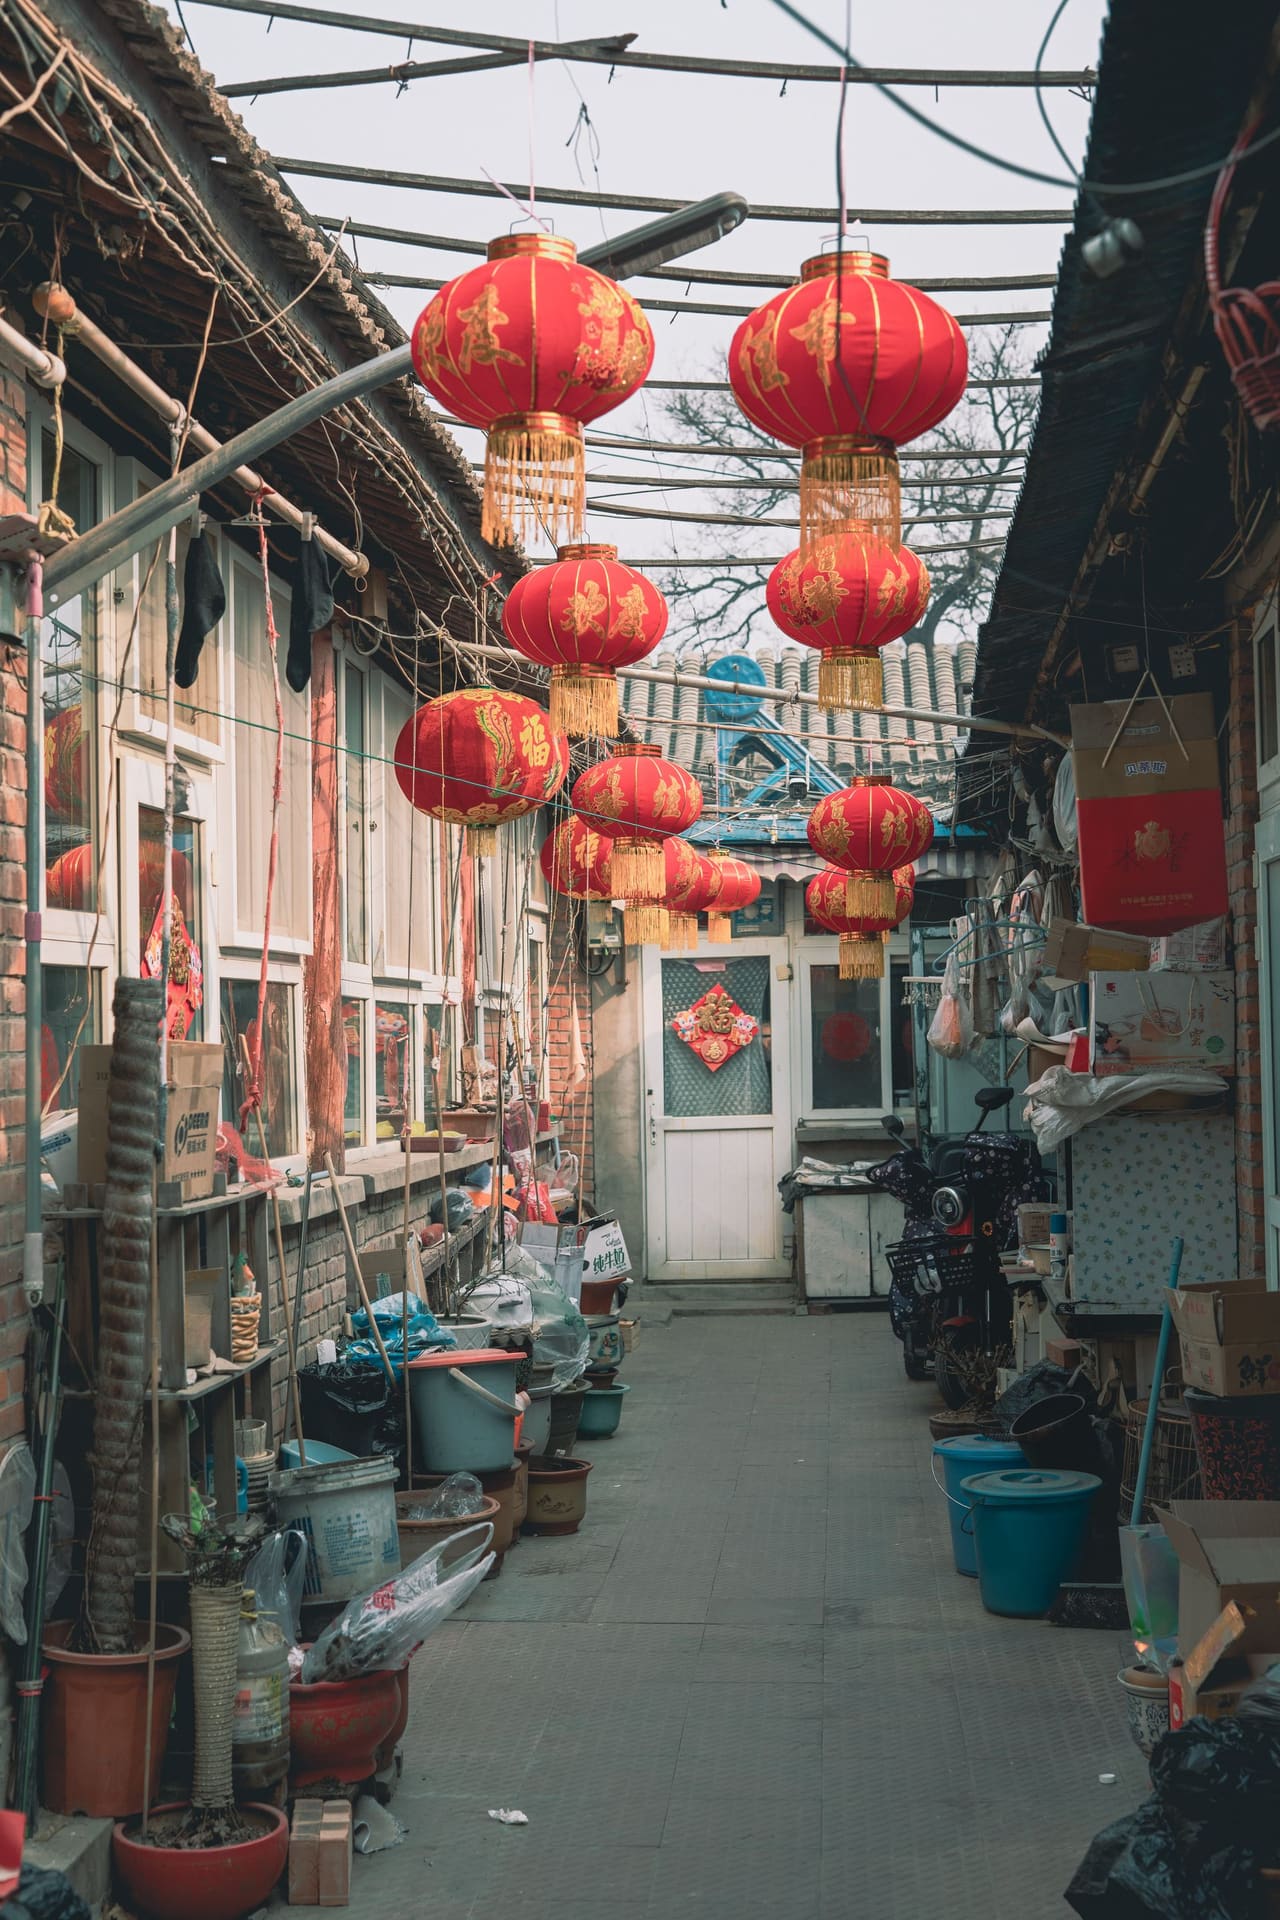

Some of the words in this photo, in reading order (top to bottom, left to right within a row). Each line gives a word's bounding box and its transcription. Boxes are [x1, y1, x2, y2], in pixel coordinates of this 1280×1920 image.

[519, 713, 550, 767] 福
[695, 992, 737, 1034] 福
[592, 1247, 625, 1275] 纯牛奶
